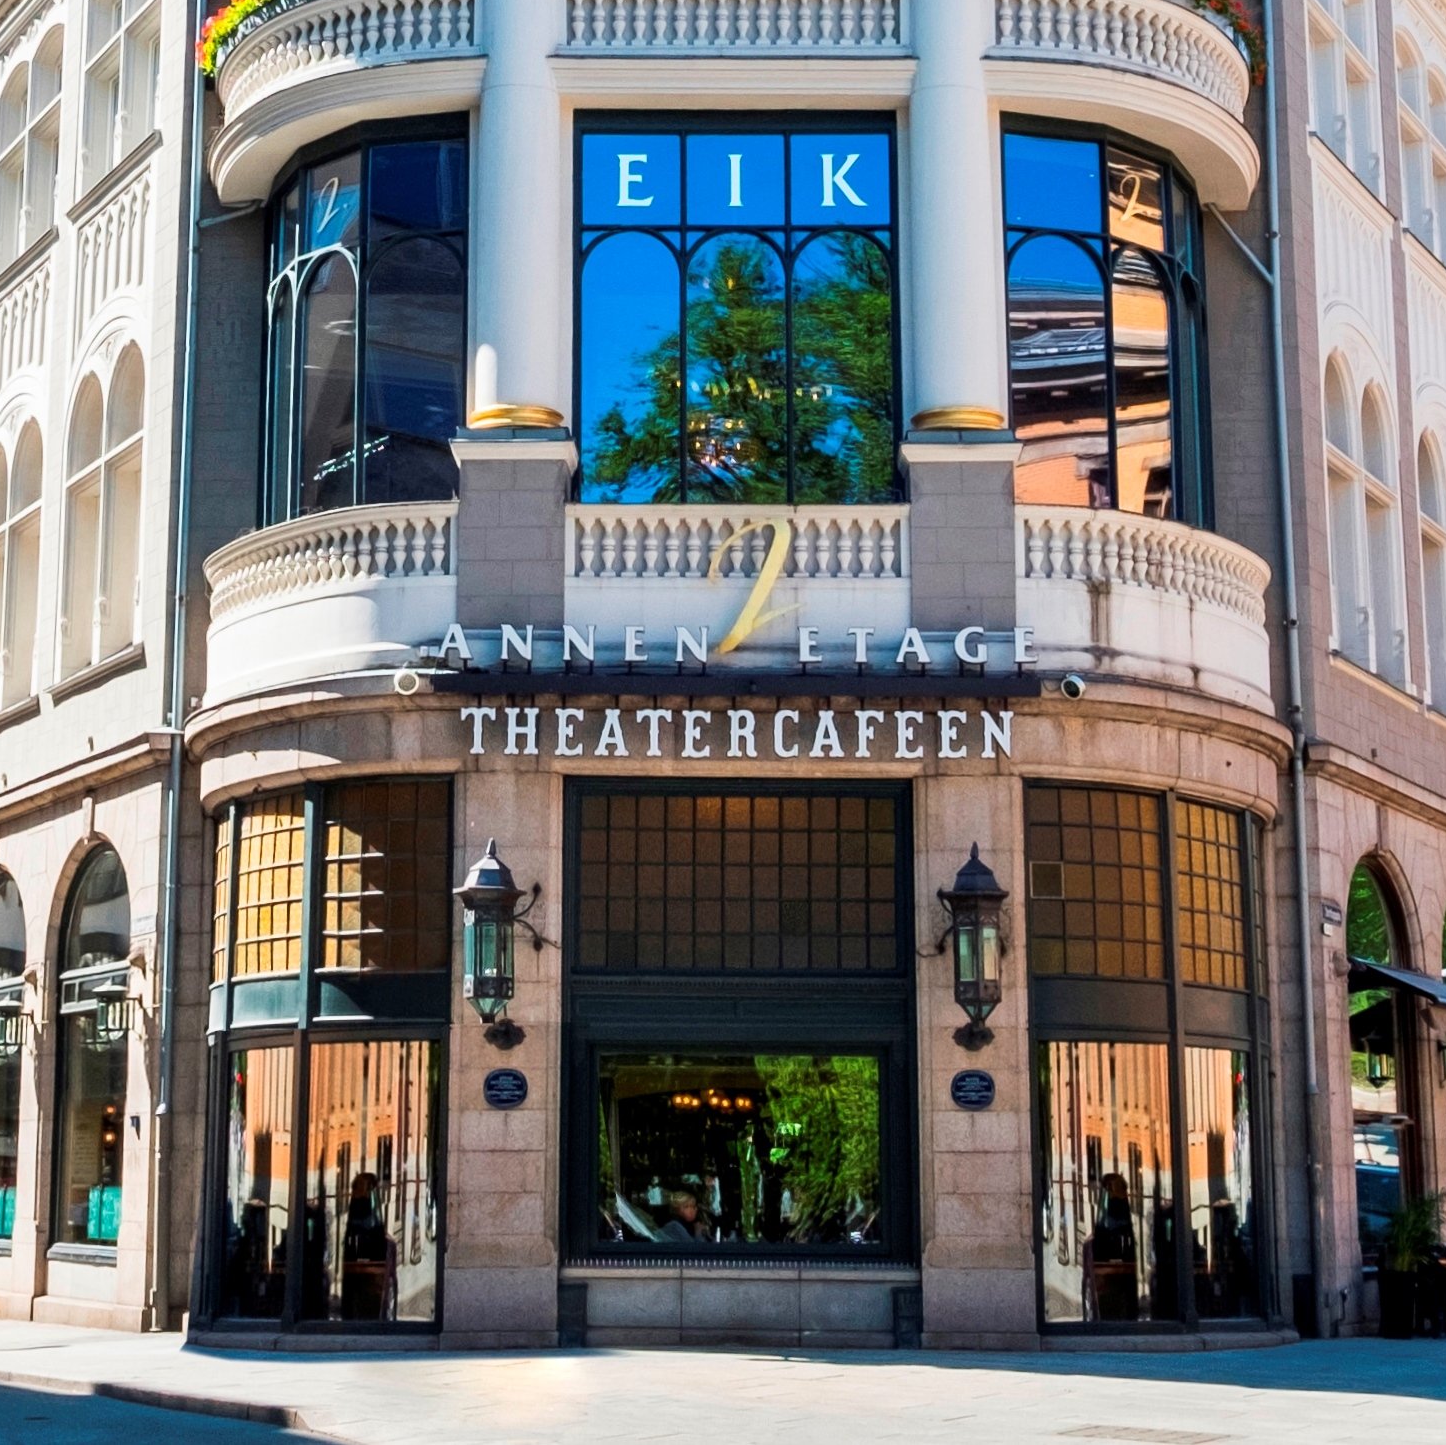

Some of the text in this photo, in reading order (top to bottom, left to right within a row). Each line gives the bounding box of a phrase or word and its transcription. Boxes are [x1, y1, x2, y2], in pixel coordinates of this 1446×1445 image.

[615, 153, 868, 207] EIK
[436, 622, 709, 664] ANNEN
[797, 624, 1039, 664] ETAGE
[460, 705, 1015, 760] THEATERCAFEEN
